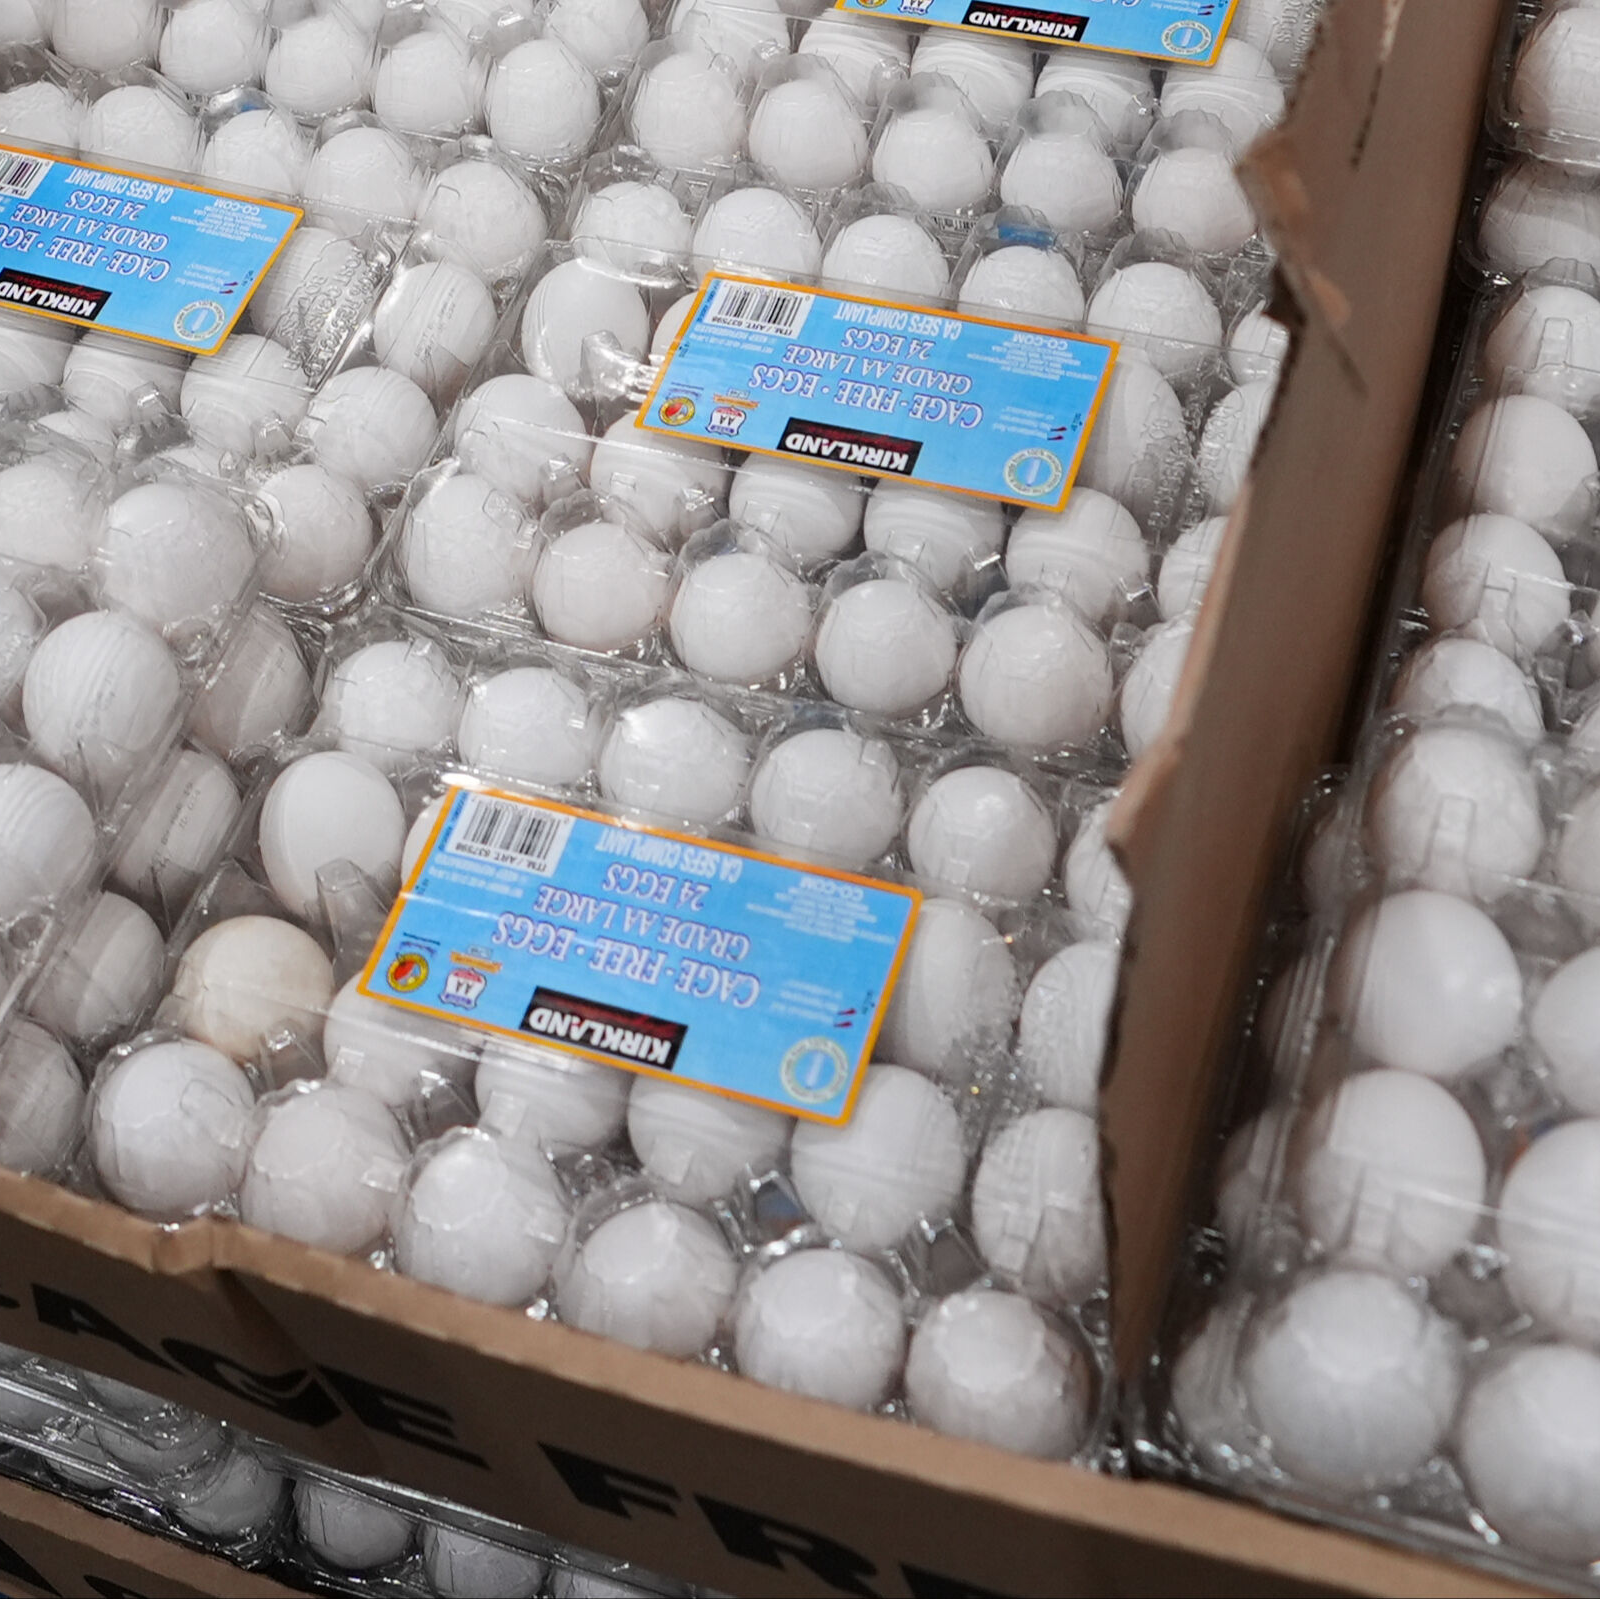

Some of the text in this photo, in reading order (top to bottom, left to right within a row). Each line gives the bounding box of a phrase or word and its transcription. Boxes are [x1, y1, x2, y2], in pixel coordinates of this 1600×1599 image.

[967, 10, 1078, 39] KIRKLAND
[63, 165, 177, 204] CA SEFS COMPLIANT
[9, 203, 76, 233] LARGE
[63, 189, 146, 222] 24 EGGS
[73, 216, 105, 238] AA
[98, 223, 168, 254] GRADE
[831, 300, 965, 341] CA SEFS COMPLIANT
[839, 326, 907, 357] EGGS
[905, 337, 935, 362] 24
[746, 365, 821, 400] EGGS
[781, 344, 972, 397] GRADE AA LARGE
[784, 432, 909, 471] KIRKLAND
[600, 862, 711, 913] 24 EGGS
[531, 884, 619, 930] LARGE
[621, 905, 660, 938] AA
[489, 912, 576, 962] EGGS
[655, 915, 750, 963] GRADE
[528, 1007, 671, 1064] KIRKLAND
